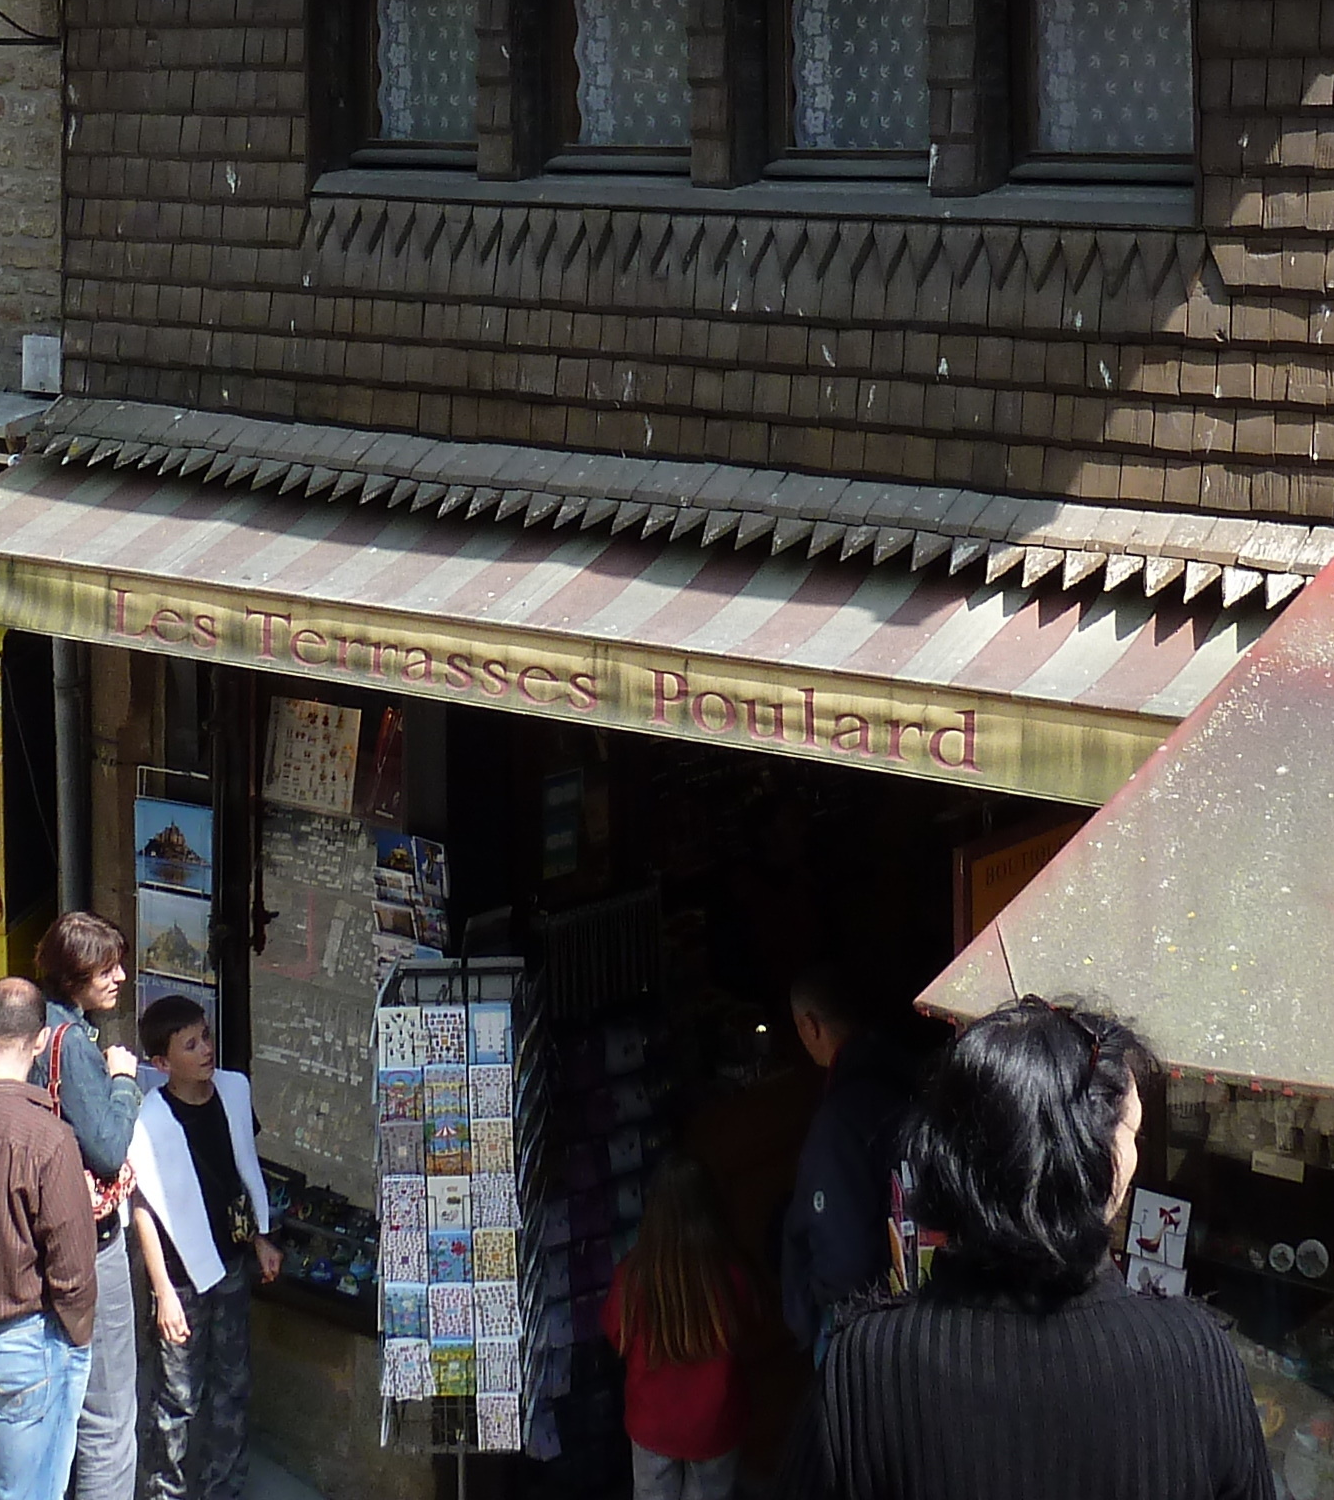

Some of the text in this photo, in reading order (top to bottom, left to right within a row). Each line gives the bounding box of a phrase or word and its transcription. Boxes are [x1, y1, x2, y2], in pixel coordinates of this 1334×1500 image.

[110, 587, 985, 773] Les Terrasses Poulard
